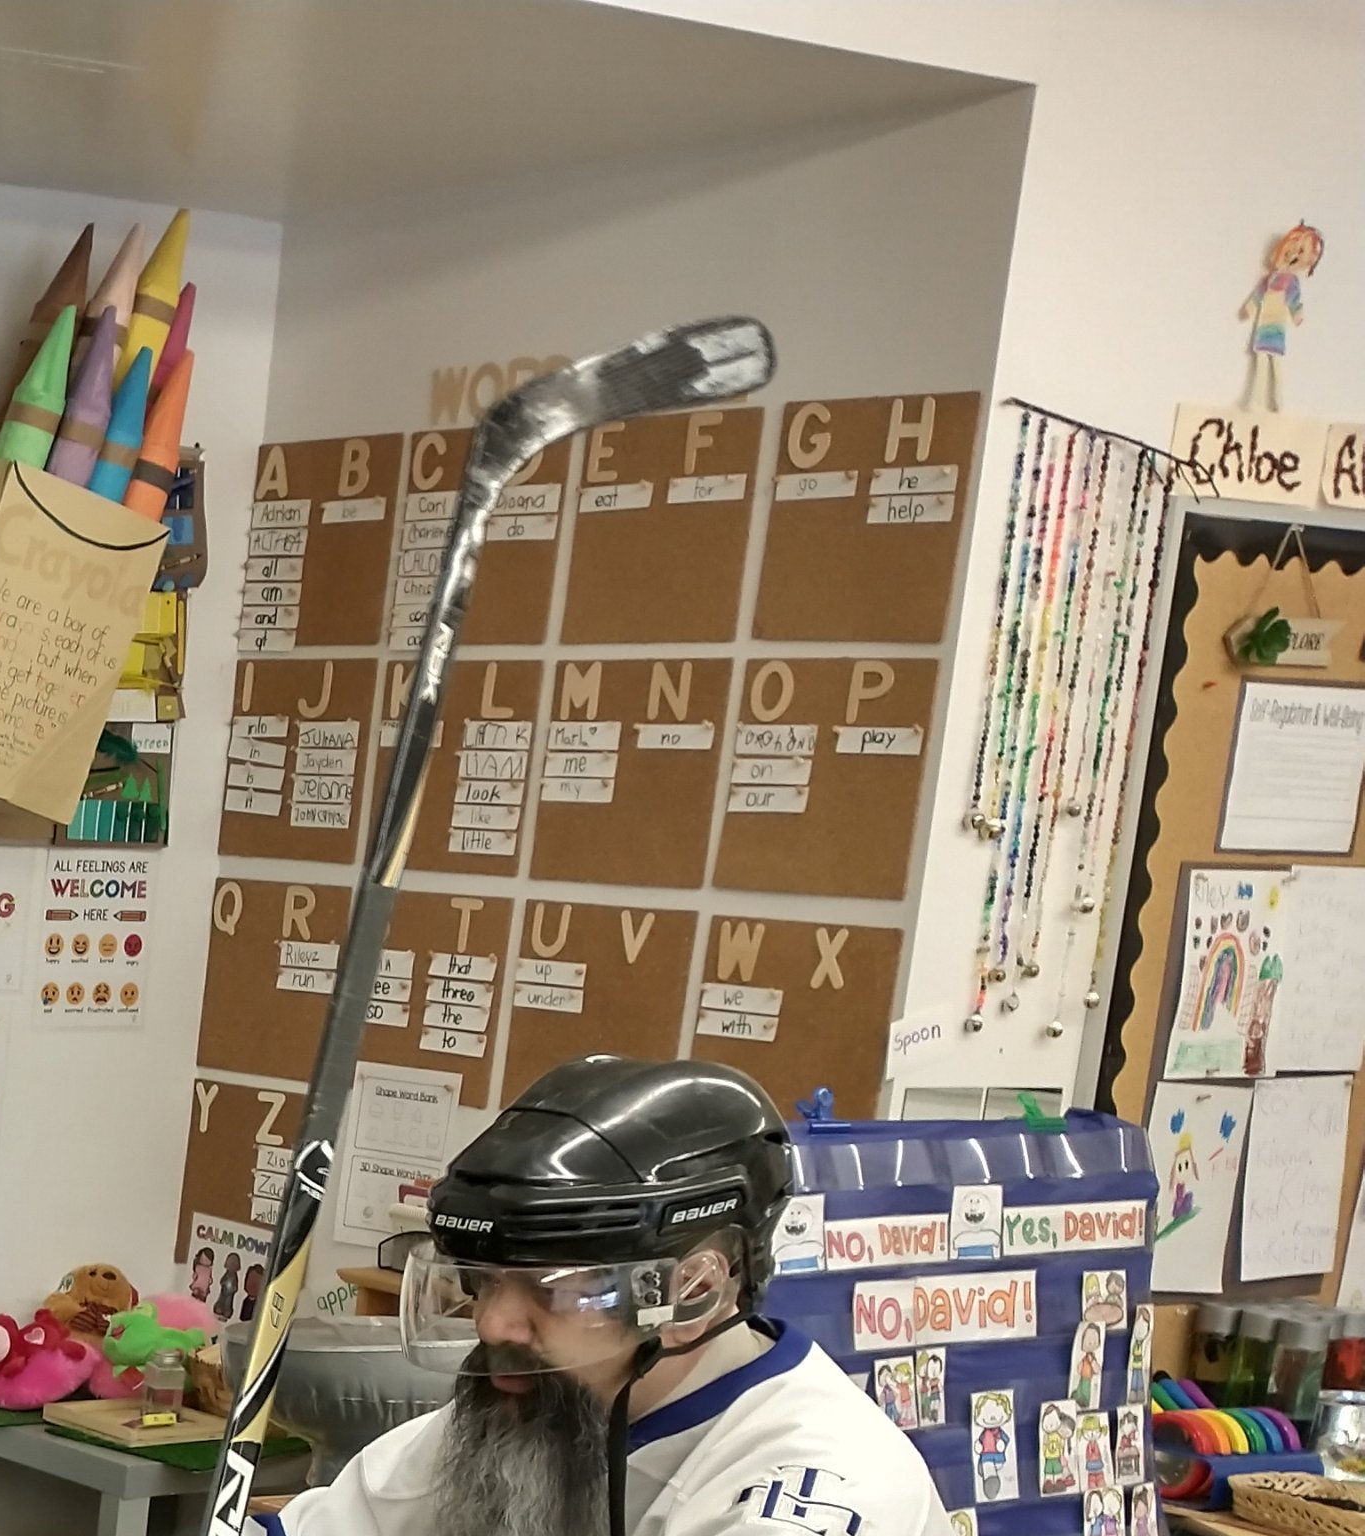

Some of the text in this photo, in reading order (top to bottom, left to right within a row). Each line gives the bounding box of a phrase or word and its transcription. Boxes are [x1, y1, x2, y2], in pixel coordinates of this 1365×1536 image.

[685, 411, 723, 474] F
[786, 402, 832, 469] G
[884, 397, 936, 464] H
[337, 438, 371, 497] B
[412, 432, 448, 491] C
[587, 422, 625, 483] E
[1188, 417, 1303, 493] Chloe
[255, 445, 289, 499] A
[798, 477, 818, 496] go
[899, 468, 919, 490] he
[595, 486, 618, 508] eat
[887, 493, 925, 523] help
[507, 517, 524, 537] do
[262, 560, 278, 578] all
[16, 595, 110, 646] are a box of
[255, 607, 278, 625] and
[64, 664, 97, 687] when
[242, 661, 255, 713] I
[297, 660, 334, 718] J
[480, 661, 514, 719] L
[559, 661, 602, 721] M
[647, 661, 693, 722] N
[750, 660, 794, 722] O
[845, 660, 895, 724] P
[12, 691, 56, 722] picture
[660, 732, 681, 745] no
[861, 730, 896, 753] play
[302, 755, 343, 774] Jayden
[563, 756, 587, 774] me
[750, 764, 773, 779] on
[465, 785, 501, 802] look
[745, 791, 774, 807] our
[470, 808, 491, 825] like
[461, 830, 492, 851] little
[54, 859, 148, 873] ALL FEELINGS ARE
[50, 878, 147, 899] WELCOME
[83, 908, 109, 921] HERE
[213, 881, 243, 937] Q
[282, 885, 316, 941] R
[450, 897, 484, 953] T
[531, 902, 572, 958] U
[621, 909, 655, 965] V
[449, 954, 472, 976] that
[717, 920, 765, 982] W
[810, 927, 849, 990] X
[292, 971, 315, 988] run
[535, 963, 552, 982] up
[527, 988, 566, 1007] under
[724, 989, 744, 1006] we
[442, 1005, 463, 1025] the
[722, 1015, 752, 1036] with
[442, 1031, 456, 1049] to
[196, 1081, 219, 1134] Y
[375, 1085, 397, 1099] Shape
[398, 1088, 419, 1102] Word
[255, 1090, 286, 1145] Z
[196, 1224, 235, 1247] CALM
[878, 1221, 946, 1256] David!
[1006, 1207, 1144, 1249] Yes, David!
[913, 1279, 1033, 1332] David!
